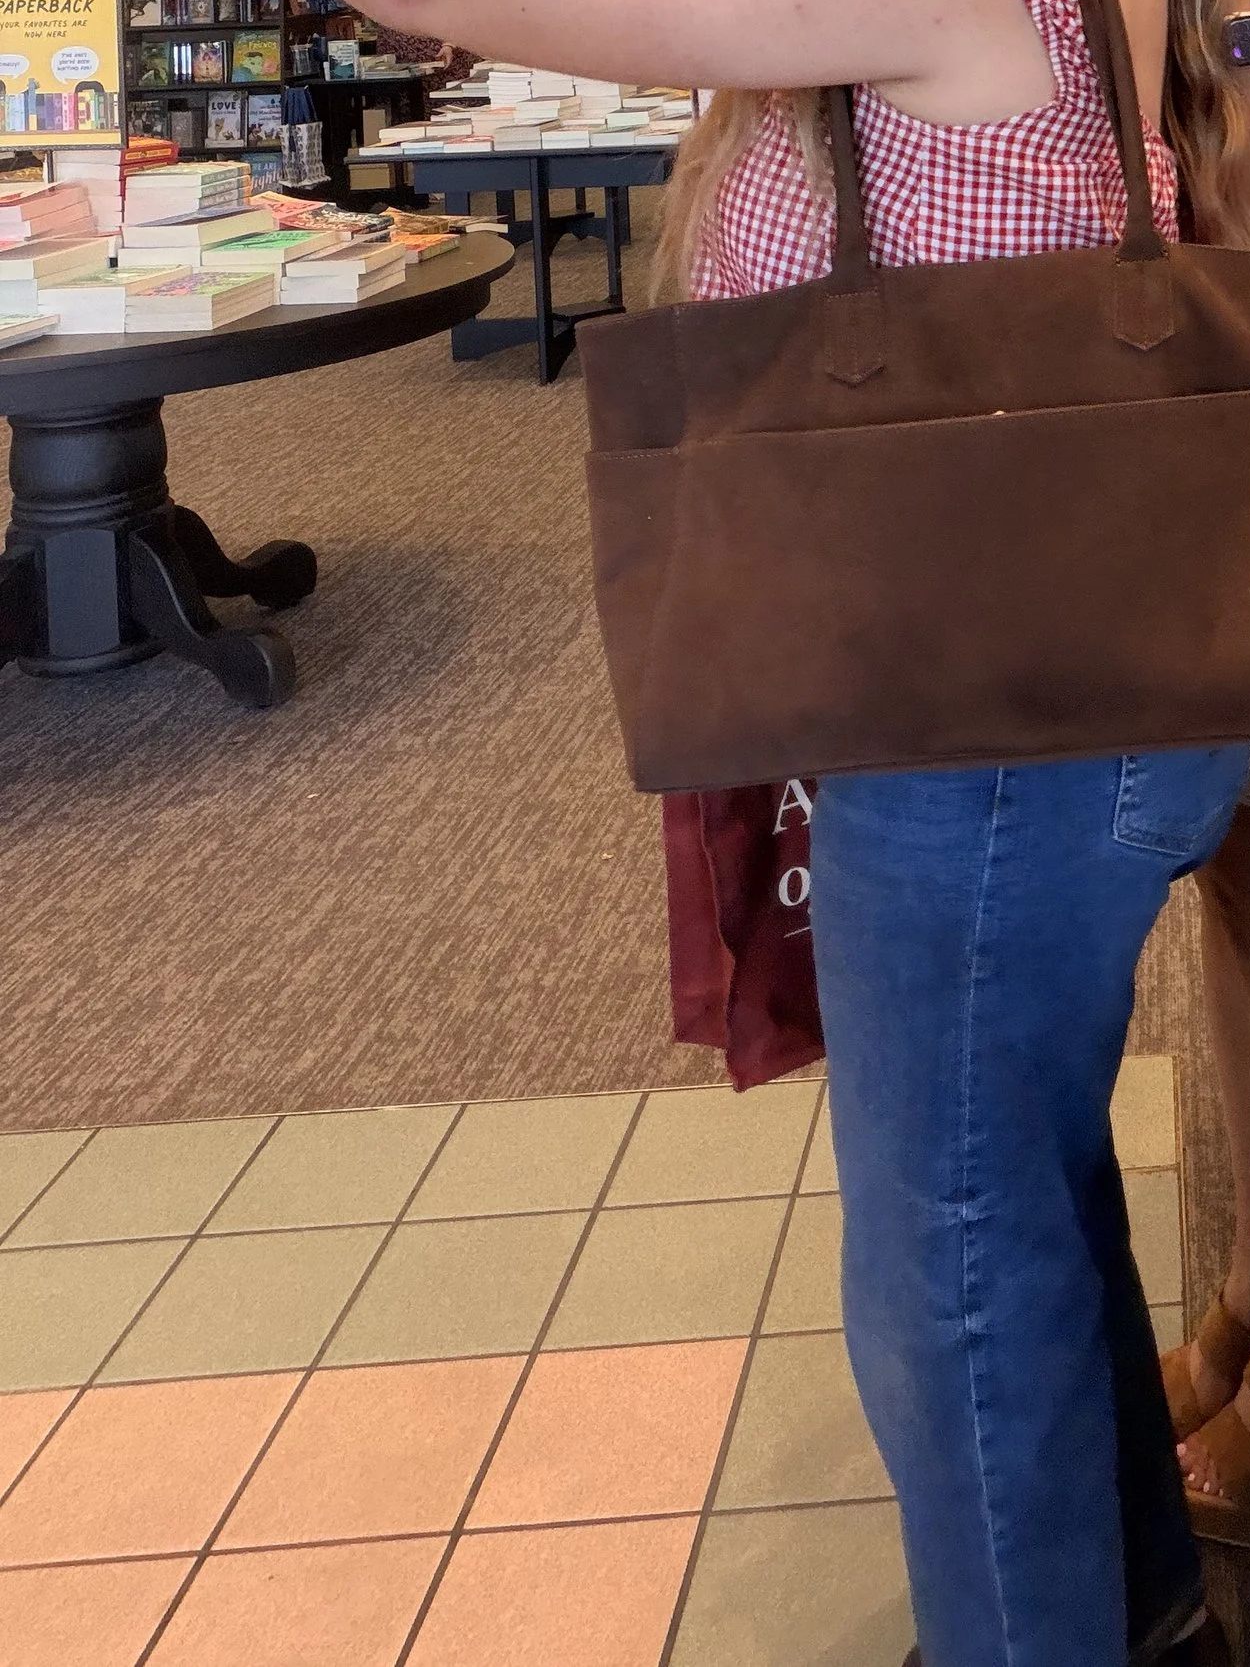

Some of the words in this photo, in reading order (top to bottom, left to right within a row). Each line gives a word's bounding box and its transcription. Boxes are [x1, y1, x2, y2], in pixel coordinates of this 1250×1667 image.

[24, 19, 67, 28] FAVORITES
[72, 19, 88, 27] ARE
[24, 31, 43, 39] NOW
[47, 30, 68, 38] HERE
